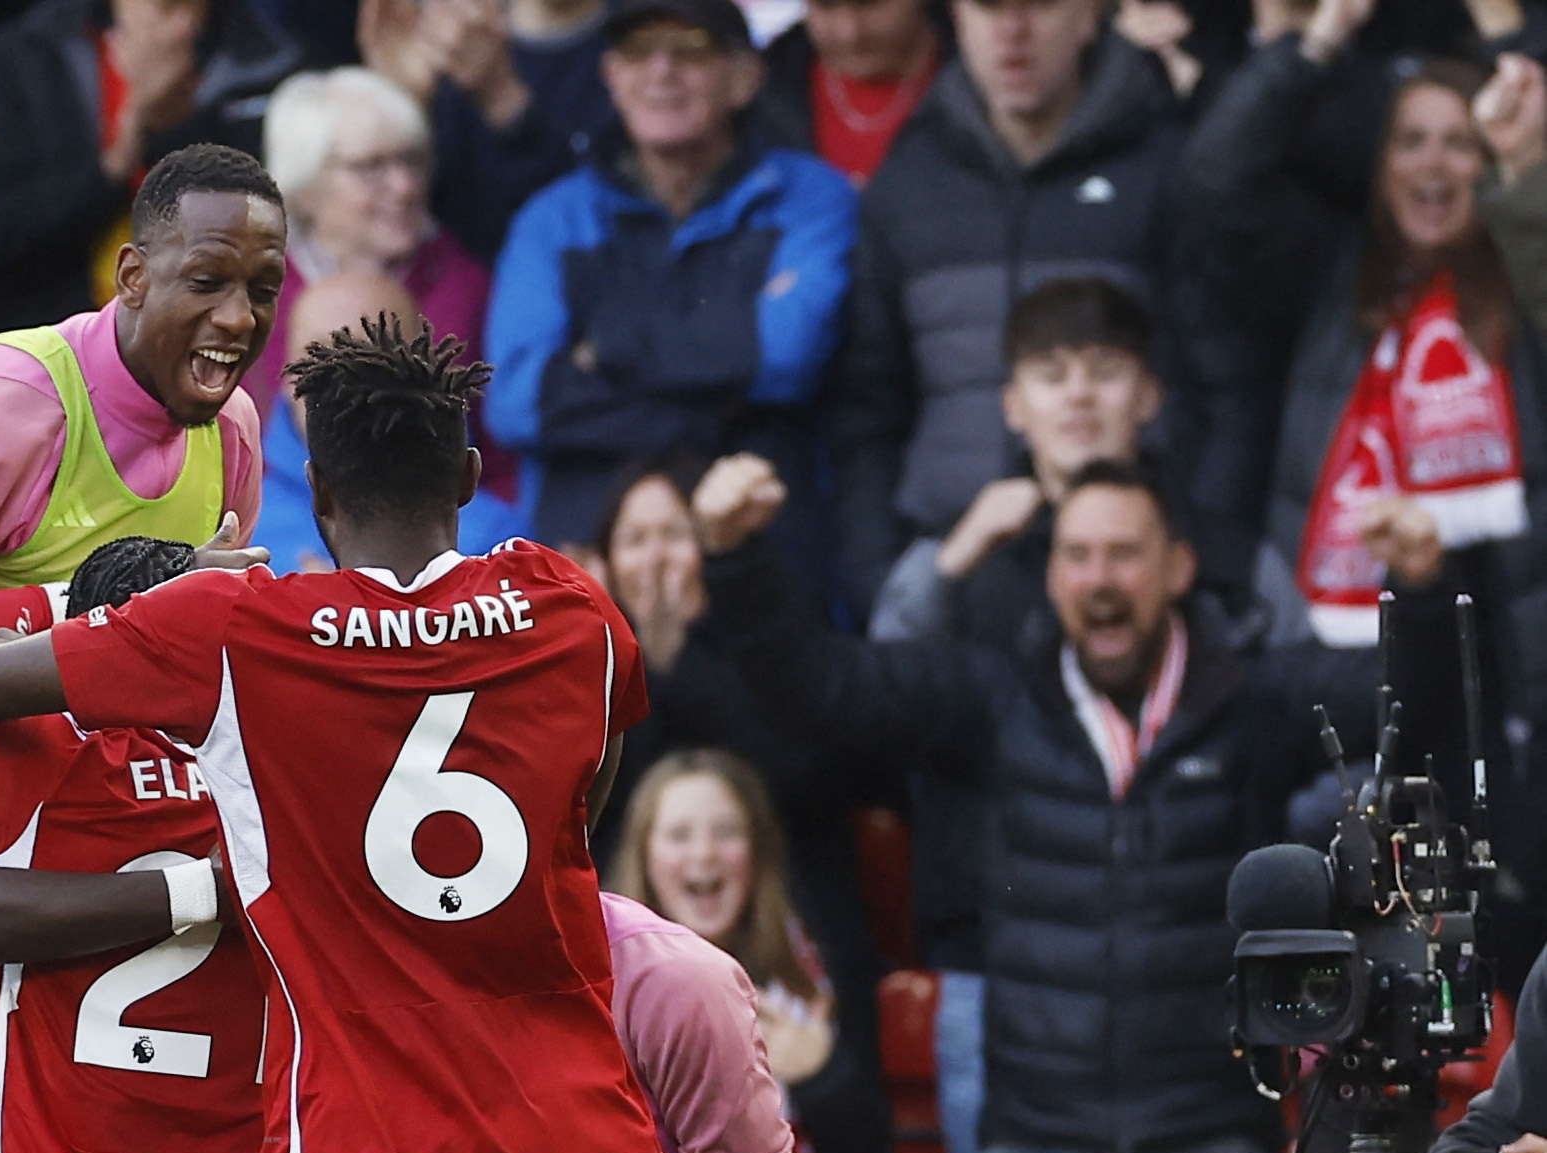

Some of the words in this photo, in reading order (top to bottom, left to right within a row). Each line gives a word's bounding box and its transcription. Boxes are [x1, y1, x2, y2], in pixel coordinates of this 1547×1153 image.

[310, 579, 534, 649] SANGARÉ
[363, 690, 530, 922] 6
[73, 850, 270, 1085] 2
